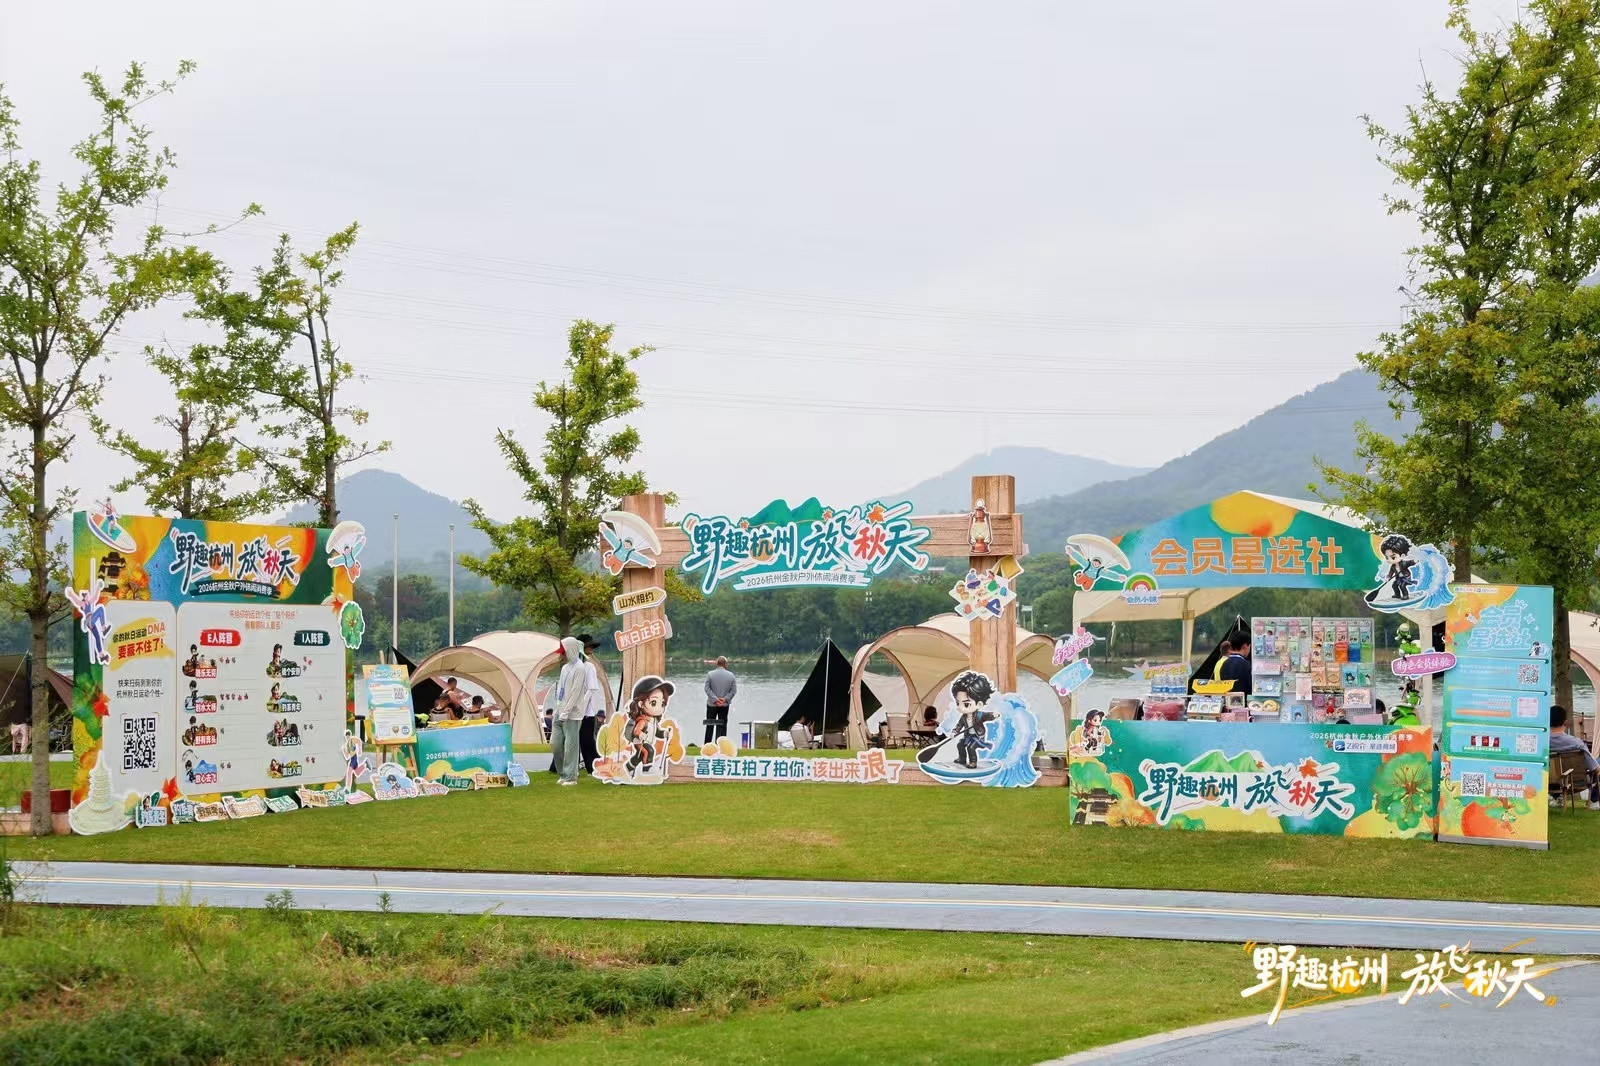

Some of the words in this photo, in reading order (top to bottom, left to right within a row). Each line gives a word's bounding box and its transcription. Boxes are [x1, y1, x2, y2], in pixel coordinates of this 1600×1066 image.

[170, 534, 234, 592] 野趣杭州
[237, 538, 298, 582] 放飞秋天
[684, 521, 795, 590] 野趣杭州
[802, 512, 922, 572] 放飞秋天
[1150, 536, 1345, 577] 会员星选社
[746, 571, 856, 587] 2026杭州金秋户外休闲消费季
[618, 591, 655, 609] 山水相约
[619, 622, 661, 649] 秋日正好
[1142, 766, 1238, 821] 野趣杭州
[1244, 768, 1348, 815] 放飞秋天
